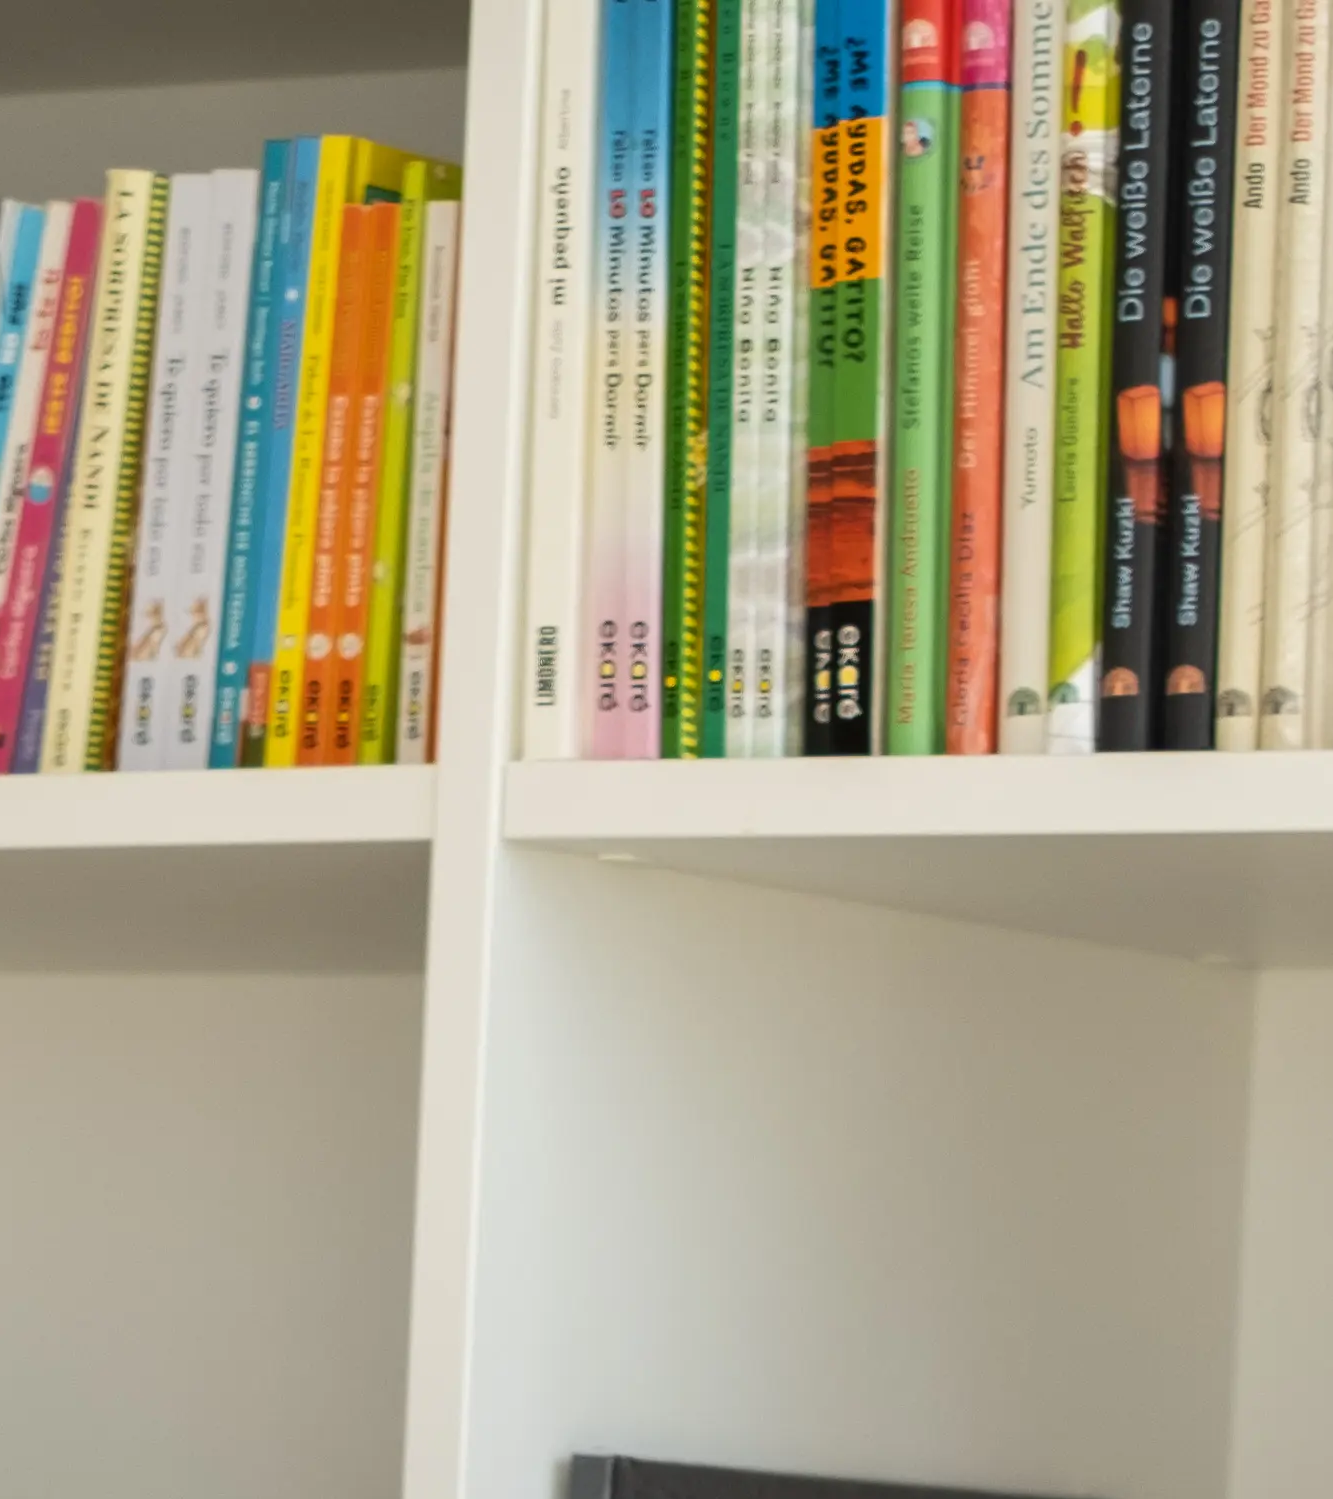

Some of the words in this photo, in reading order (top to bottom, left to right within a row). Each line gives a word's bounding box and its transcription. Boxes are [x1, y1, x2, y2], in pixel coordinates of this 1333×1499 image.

[1251, 30, 1270, 50] zu
[1296, 26, 1316, 47] zu
[1123, 21, 1155, 150] Laterne
[1190, 17, 1224, 147] Laterne
[1245, 55, 1271, 109] Mond
[1290, 51, 1316, 105] Mond
[1243, 112, 1268, 147] Der
[1288, 107, 1314, 143] Der
[113, 189, 135, 222] LA
[1022, 149, 1051, 211] des
[1118, 160, 1151, 258] weiße
[1185, 156, 1218, 255] weiße
[1241, 161, 1267, 210] Ando
[1287, 157, 1312, 205] Ando
[1021, 223, 1049, 315] Ende
[1118, 266, 1146, 321] Die
[1183, 260, 1213, 319] Die
[95, 230, 133, 374] SORPRESA
[1019, 329, 1047, 389] Am
[92, 380, 116, 414] DE
[1113, 496, 1138, 559] Kuzki
[1178, 492, 1205, 557] Kuzki
[1111, 566, 1135, 628] Shaw
[1175, 561, 1201, 625] Shaw
